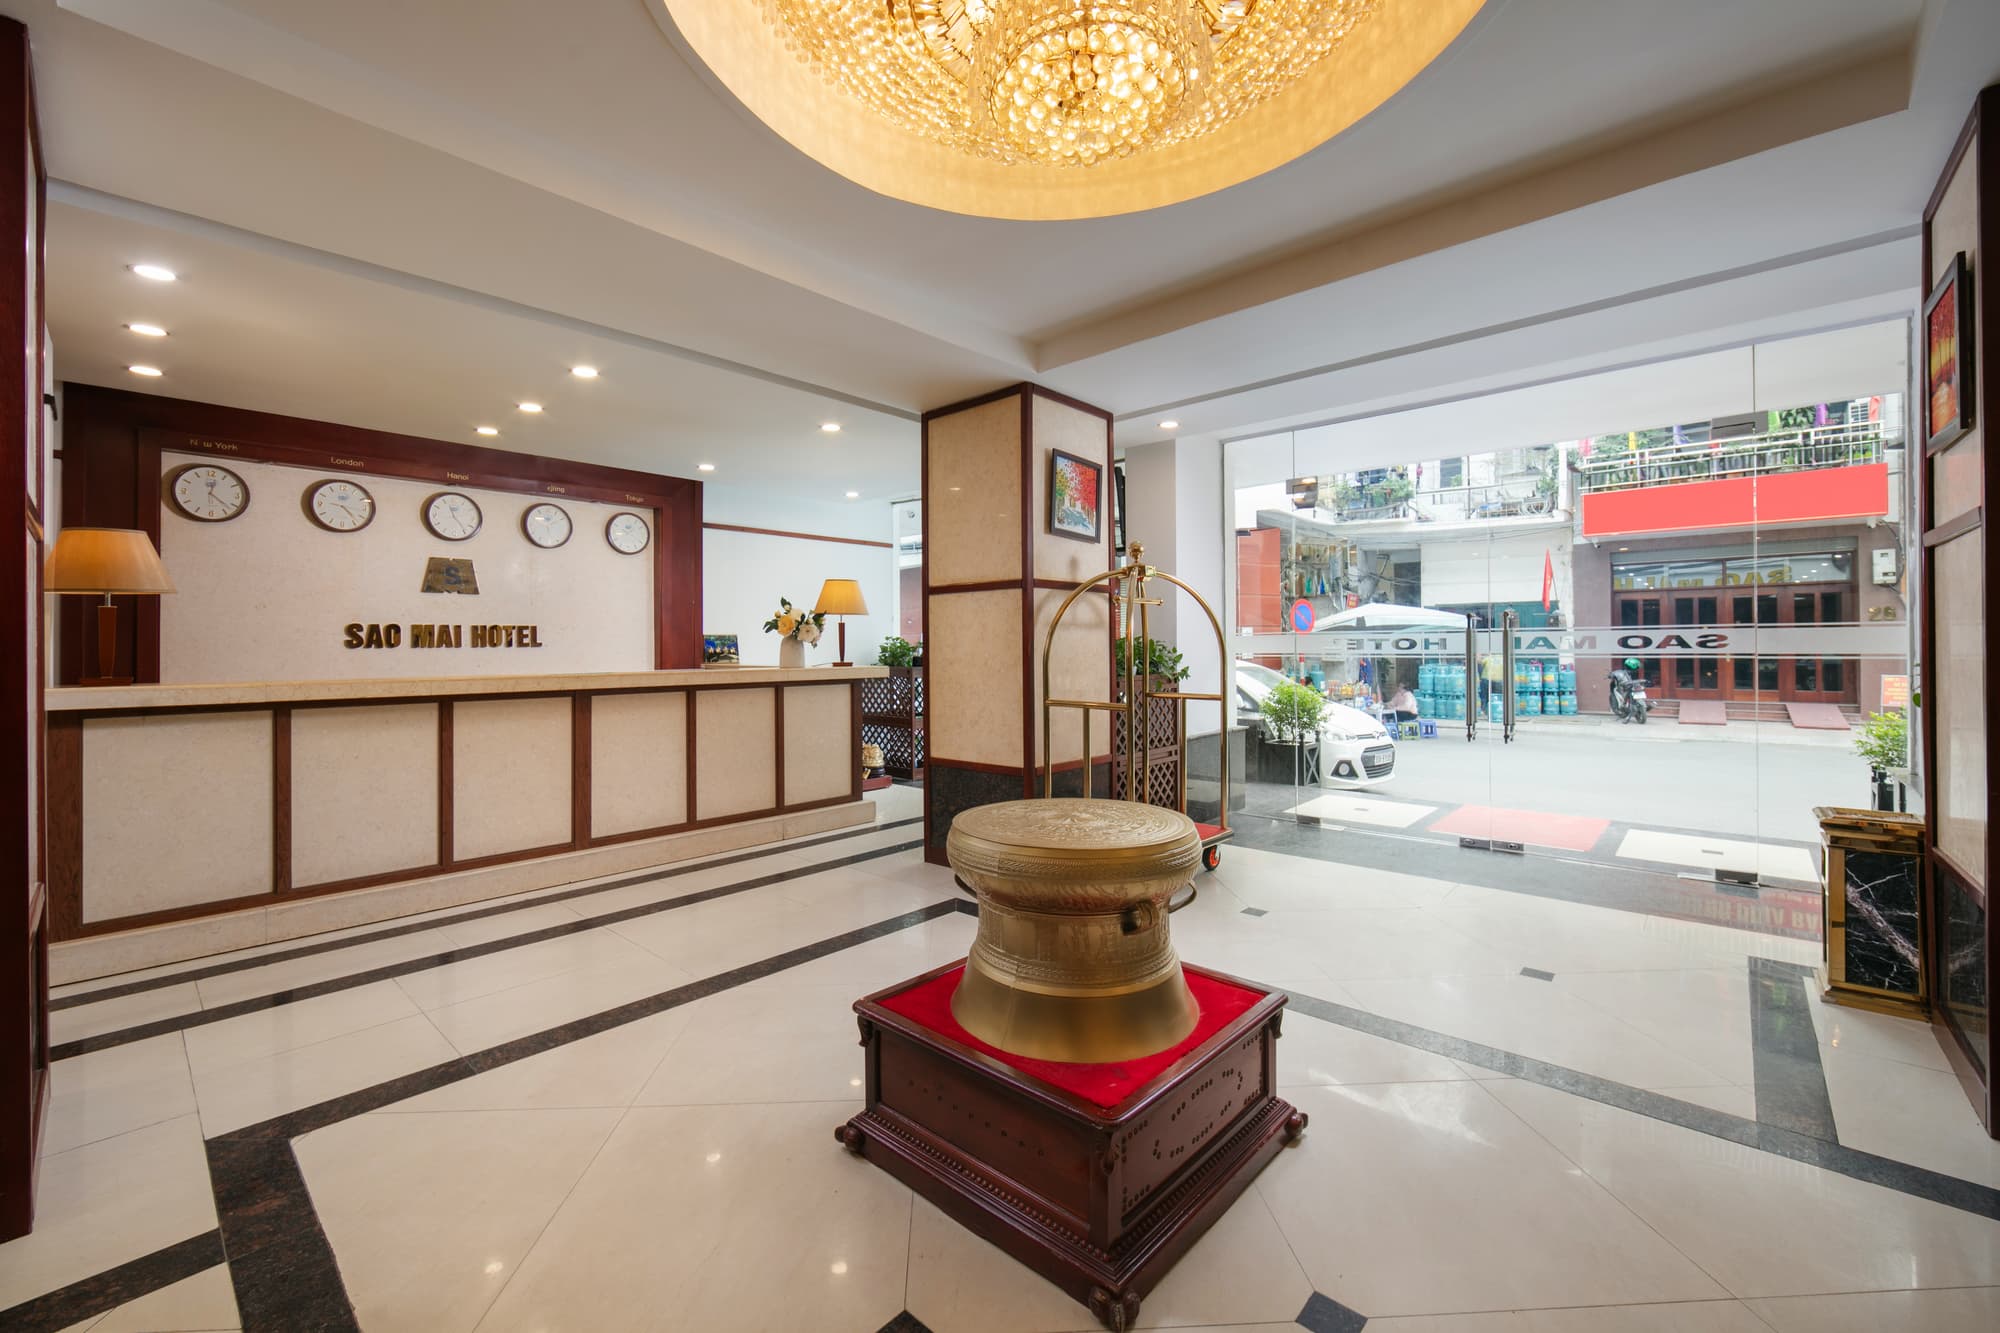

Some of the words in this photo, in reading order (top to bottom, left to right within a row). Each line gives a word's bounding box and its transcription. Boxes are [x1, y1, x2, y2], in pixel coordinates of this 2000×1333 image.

[190, 439, 212, 448] Nw
[215, 441, 239, 451] York
[330, 456, 365, 468] London
[447, 471, 470, 481] Hanoi
[343, 623, 401, 649] SAO
[410, 624, 462, 649] MAI
[470, 624, 543, 649] HOTEL
